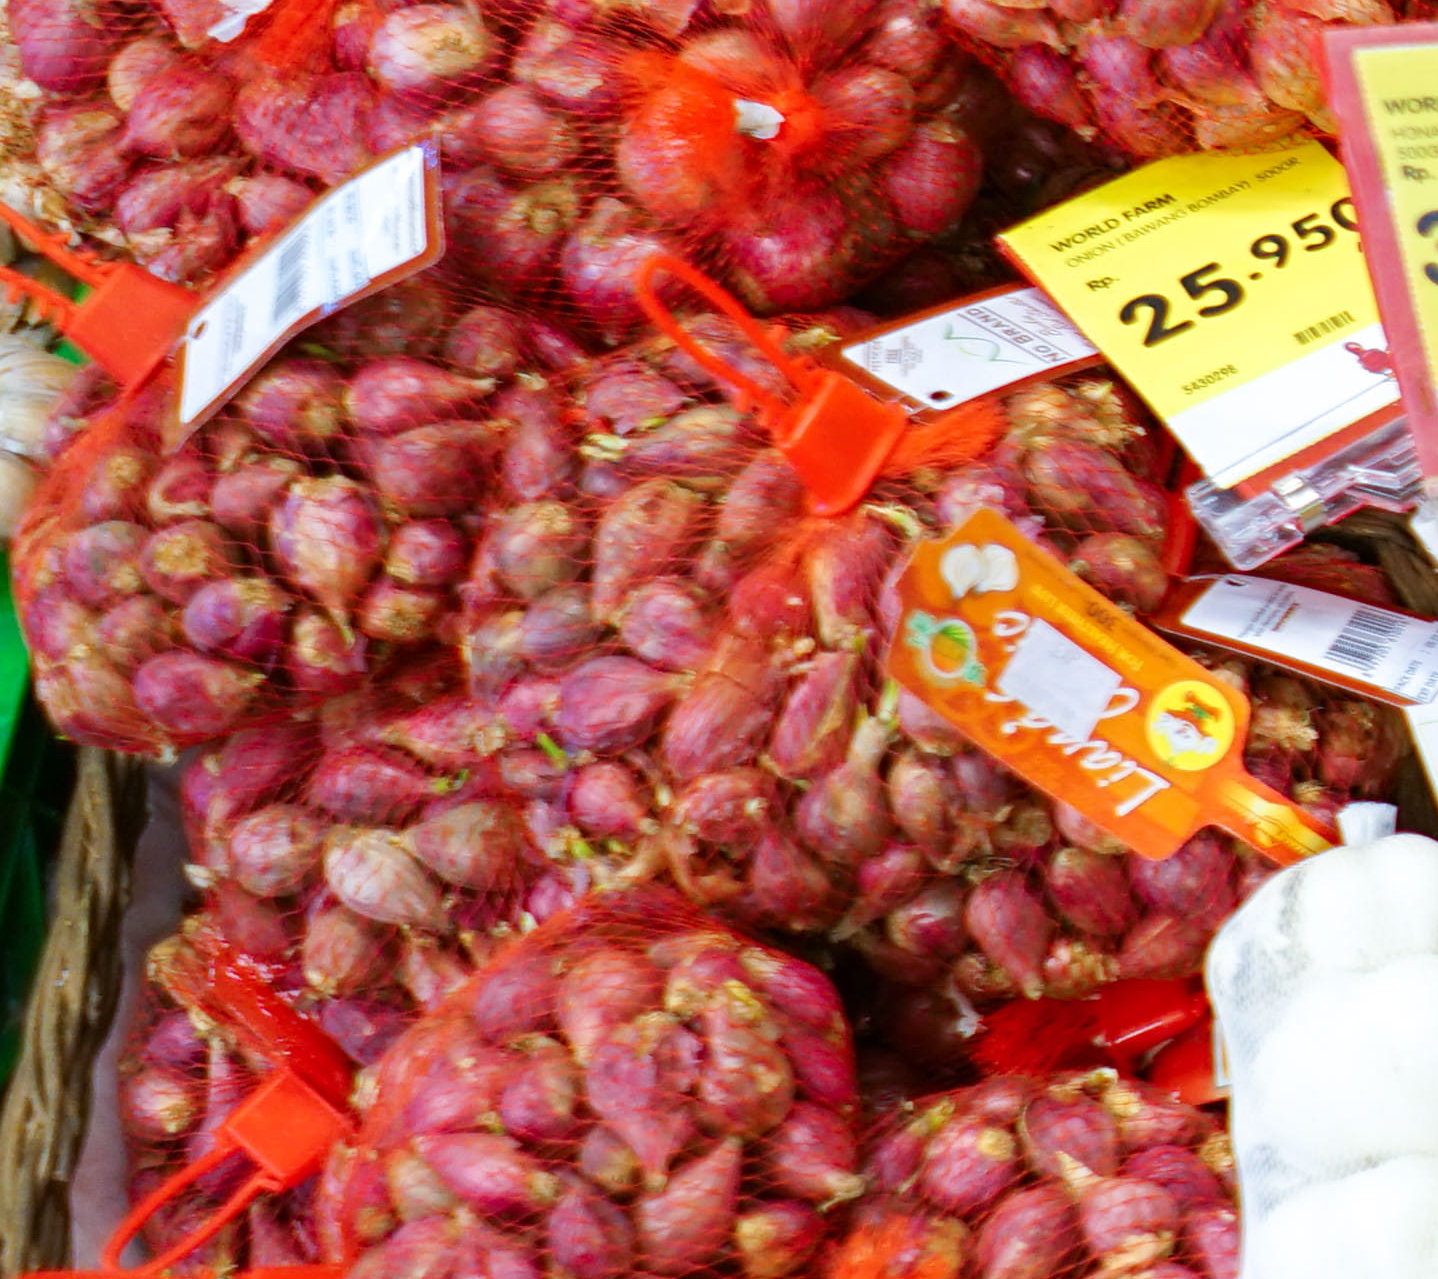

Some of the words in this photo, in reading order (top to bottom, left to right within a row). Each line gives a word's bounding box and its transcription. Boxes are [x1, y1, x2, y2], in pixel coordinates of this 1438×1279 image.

[1401, 165, 1436, 183] Rp.
[1050, 214, 1121, 254] WORLD
[1121, 193, 1177, 223] FARM
[1086, 275, 1121, 293] Rp.
[1119, 196, 1361, 349] 25.950
[966, 306, 1027, 346] BRAND
[1035, 344, 1067, 363] NO
